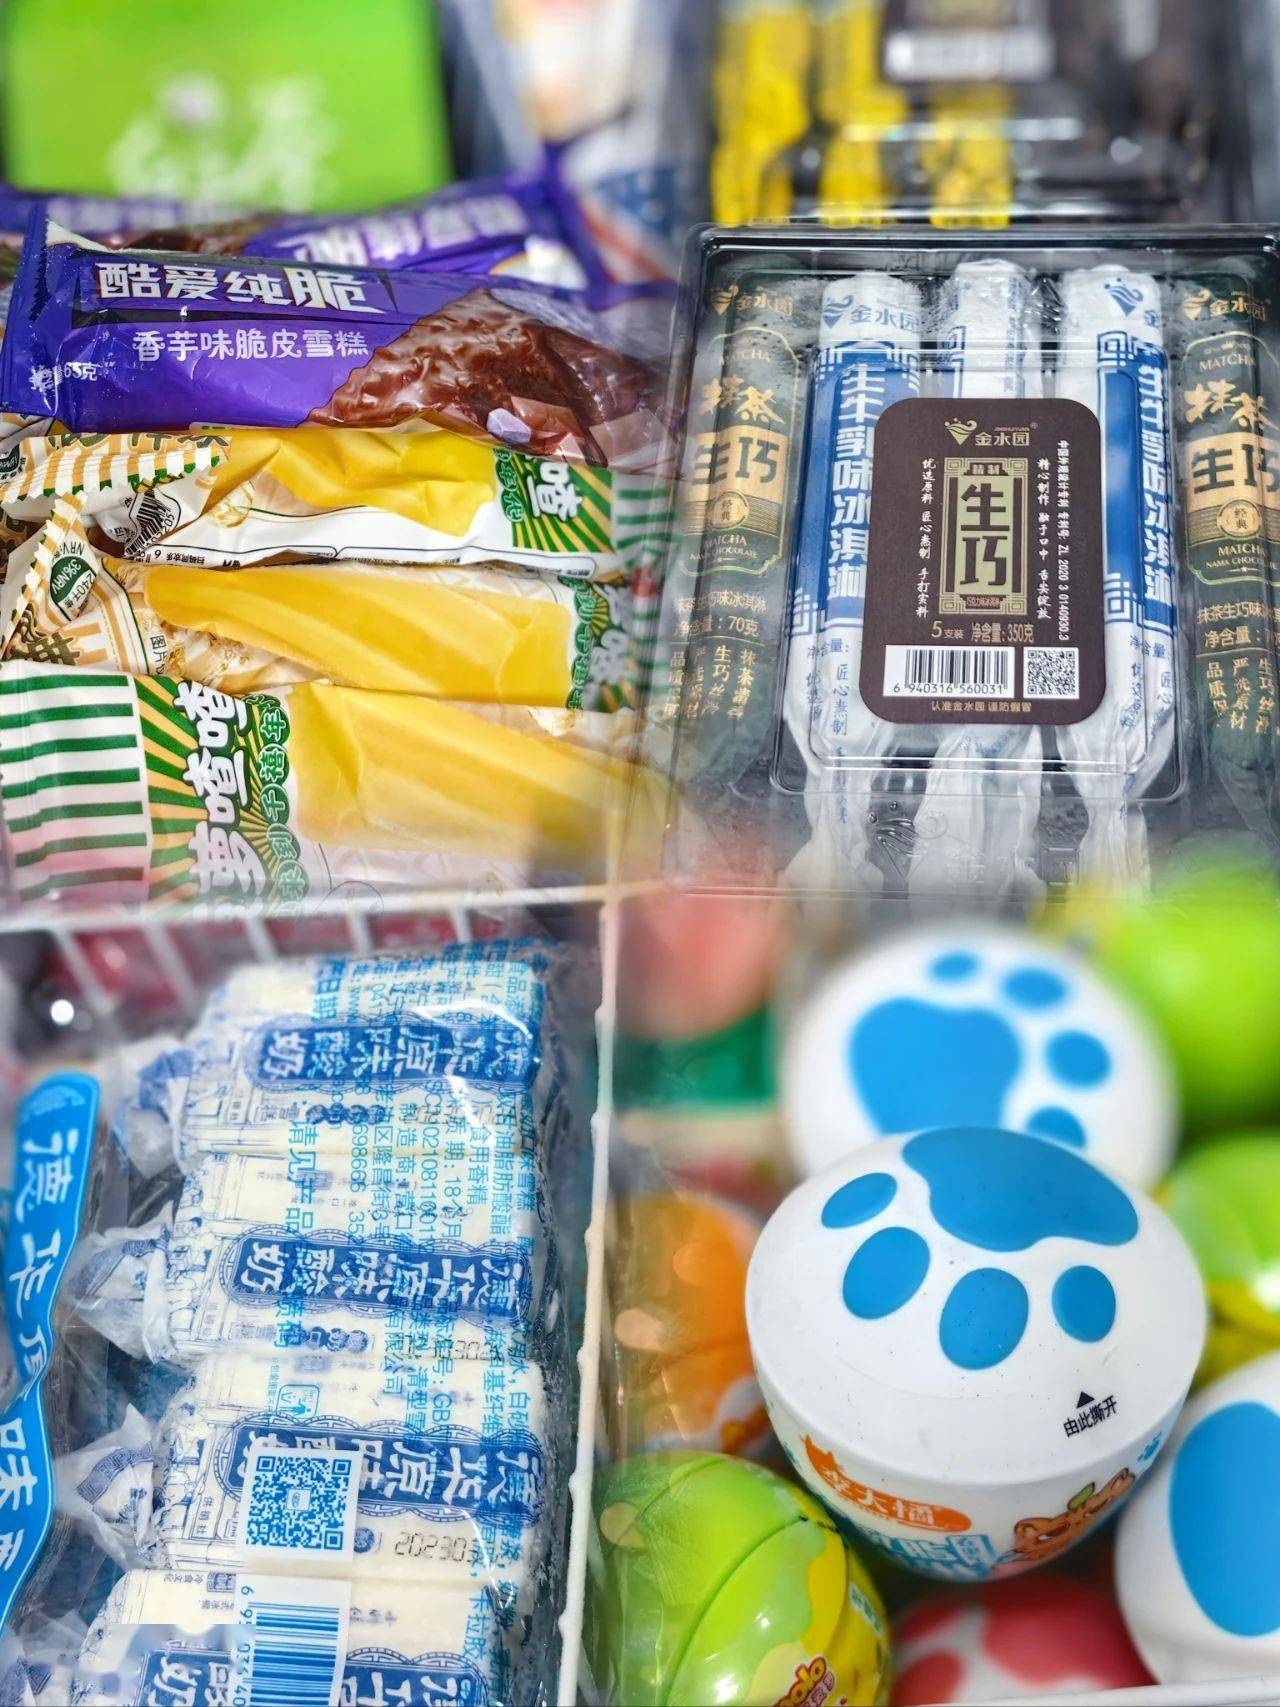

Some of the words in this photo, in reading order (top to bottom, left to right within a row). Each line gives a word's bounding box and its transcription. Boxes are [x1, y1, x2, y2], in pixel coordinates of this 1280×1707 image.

[95, 262, 389, 314] 酷爱纯脆
[132, 329, 370, 362] 香芋味脆皮雪糕
[975, 432, 1030, 446] 金水园
[960, 483, 1010, 586] 生巧
[51, 558, 82, 595] 3%NRV
[1057, 559, 1069, 581] 2020
[931, 620, 964, 640] 5支装
[893, 684, 901, 693] 6
[908, 683, 954, 694] 940316
[959, 684, 1003, 694] 560031
[1063, 1394, 1117, 1438] 由此撕开
[240, 1585, 254, 1596] 6
